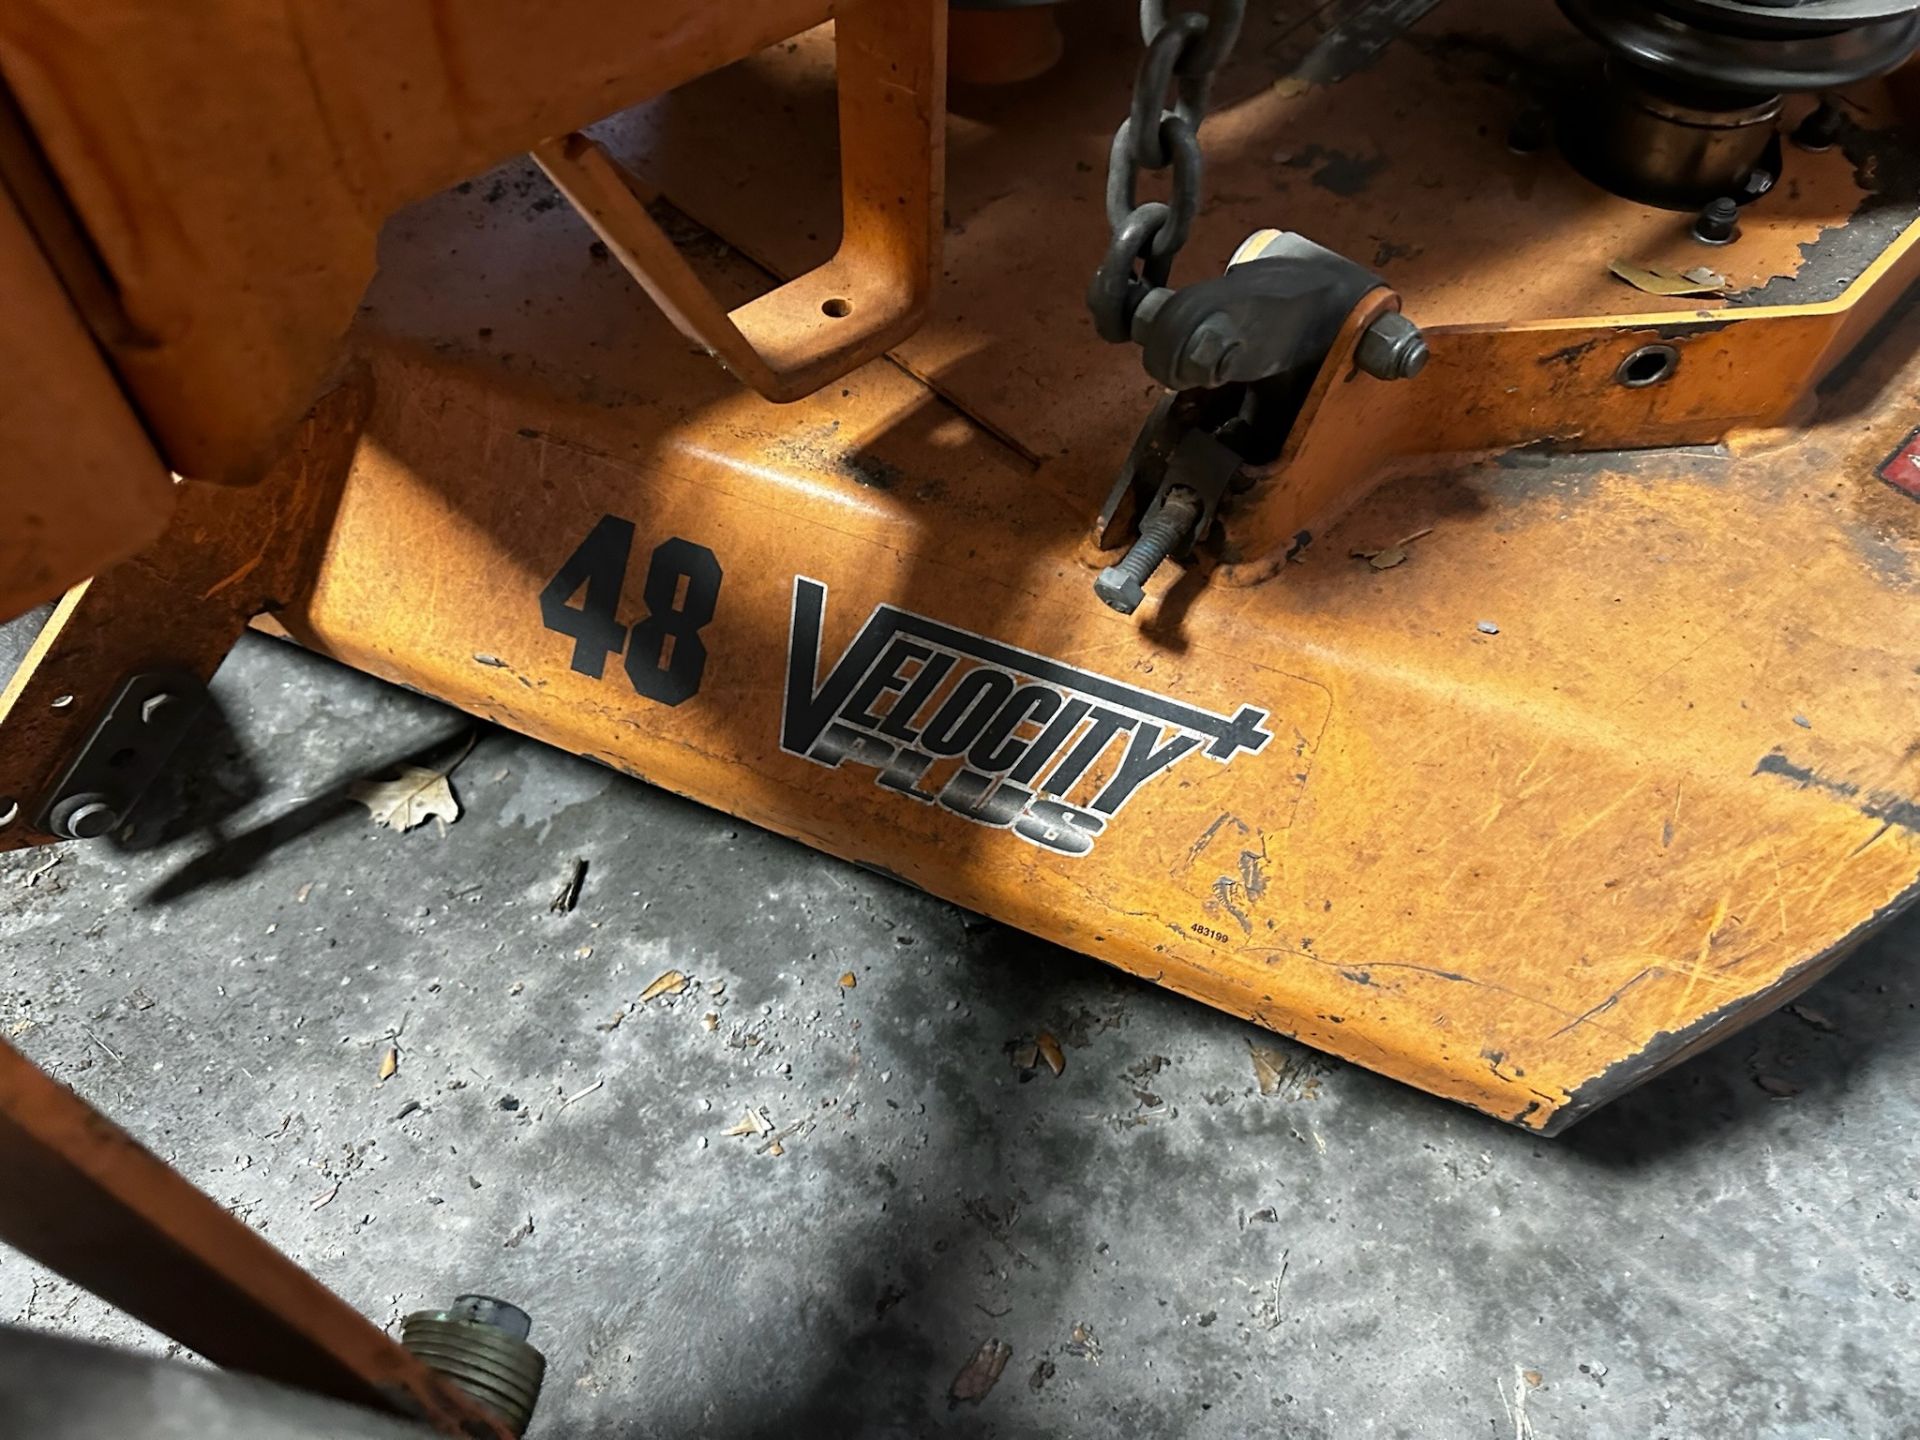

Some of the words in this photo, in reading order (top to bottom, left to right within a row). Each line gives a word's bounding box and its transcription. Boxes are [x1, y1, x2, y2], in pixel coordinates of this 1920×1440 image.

[539, 513, 723, 707] 48
[807, 722, 1107, 856] PLUS
[1190, 923, 1229, 943] 483199
